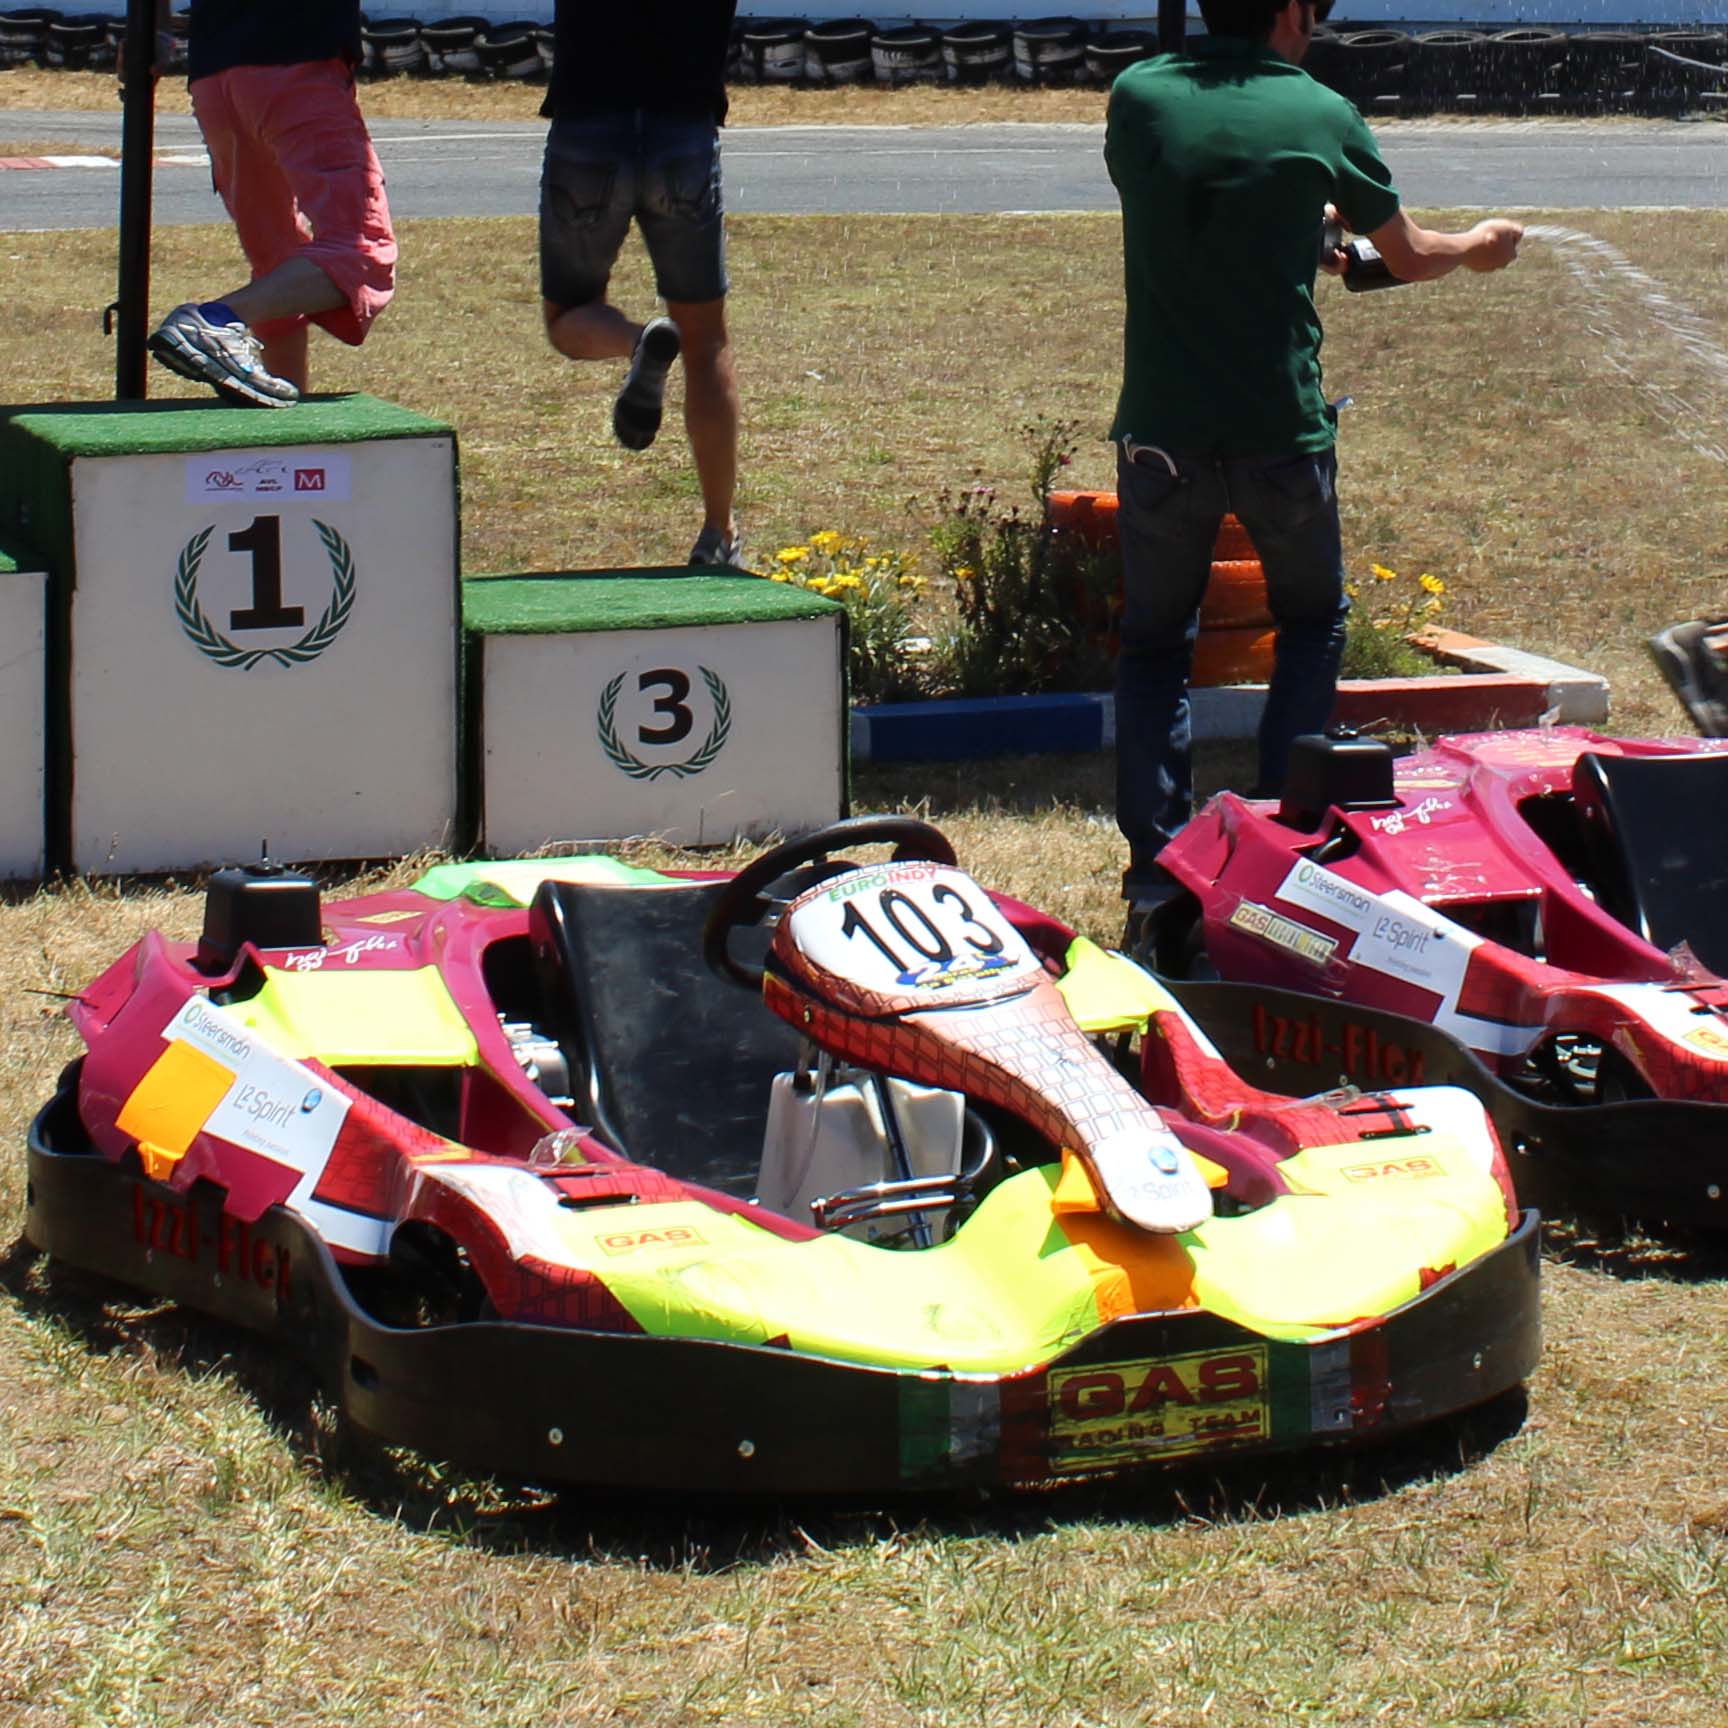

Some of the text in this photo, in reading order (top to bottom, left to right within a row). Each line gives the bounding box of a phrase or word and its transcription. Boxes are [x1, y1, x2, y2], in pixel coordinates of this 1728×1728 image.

[228, 514, 305, 630] 1
[637, 668, 694, 745] 3
[828, 868, 938, 902] EUROINDY
[841, 883, 1005, 973] 103
[1060, 1354, 1260, 1420] GAS
